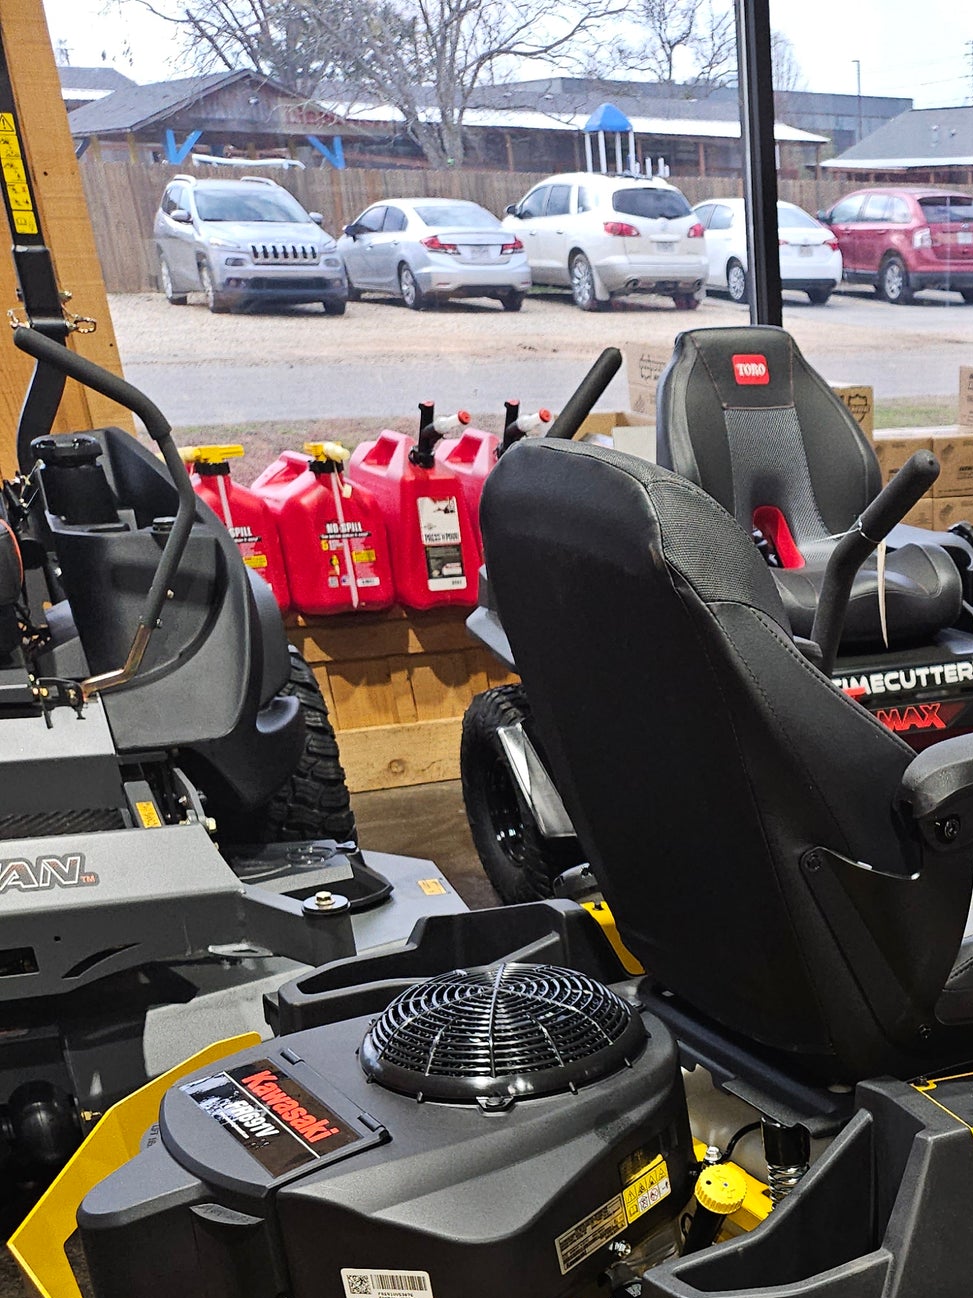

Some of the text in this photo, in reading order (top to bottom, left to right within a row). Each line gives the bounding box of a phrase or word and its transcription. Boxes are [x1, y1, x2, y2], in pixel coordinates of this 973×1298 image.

[736, 362, 767, 377] TORO
[876, 703, 946, 731] MAX
[229, 1099, 280, 1138] FR691V
[241, 1069, 340, 1144] Kawasaki
